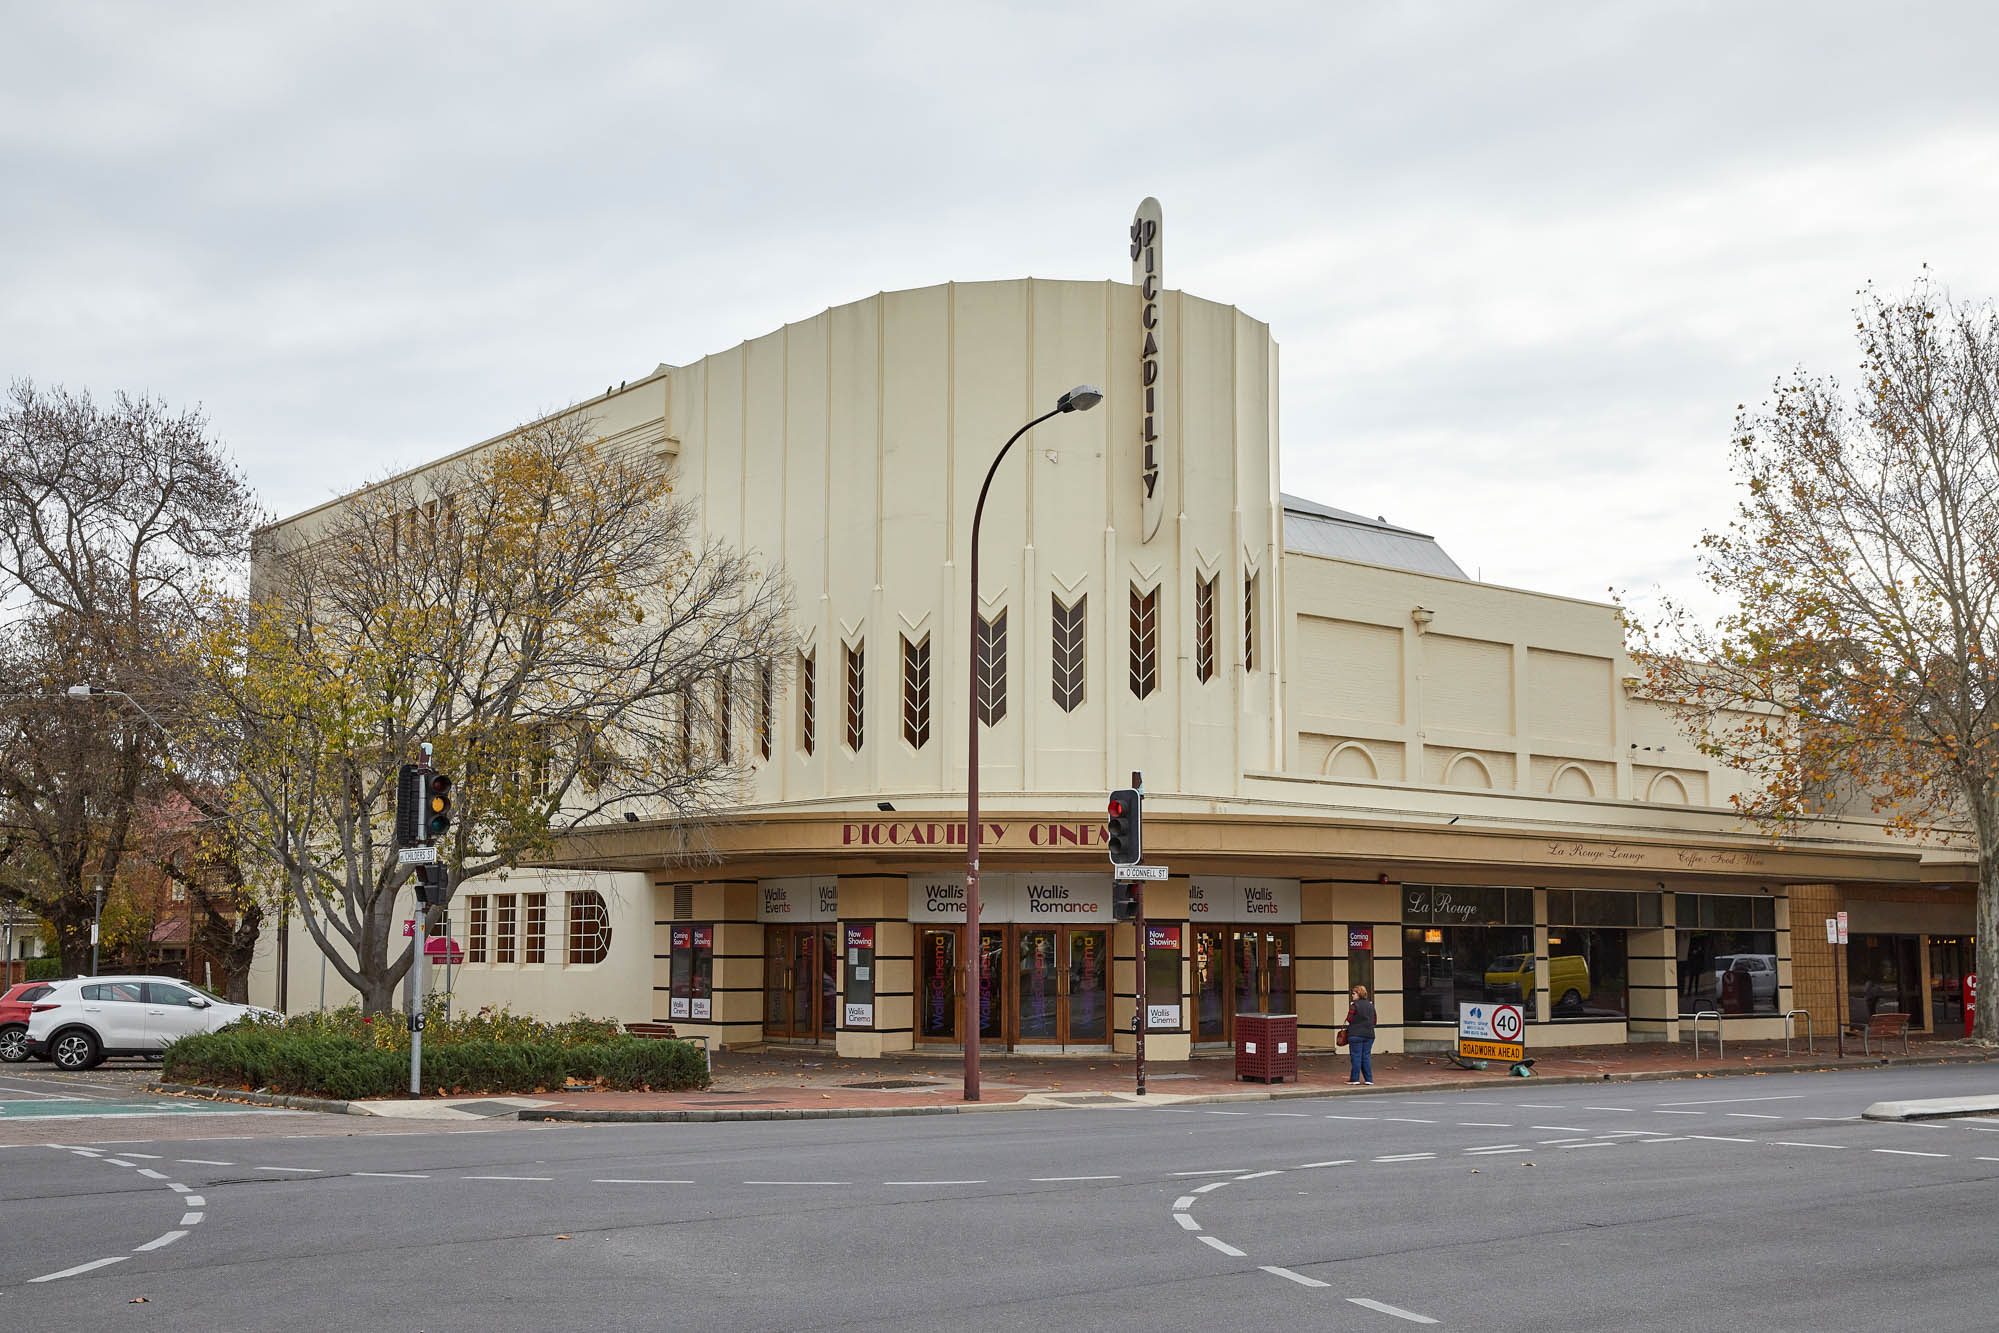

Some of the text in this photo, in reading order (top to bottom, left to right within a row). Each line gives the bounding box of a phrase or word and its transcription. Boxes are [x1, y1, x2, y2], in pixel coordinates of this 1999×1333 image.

[1142, 219, 1158, 499] PICCADILLY
[843, 823, 1110, 846] PICCADILLY CINEM
[1547, 842, 1645, 865] La Rouge Lounge
[1159, 869, 1165, 878] ST
[764, 887, 786, 900] Wallis
[926, 885, 964, 899] Wallis
[1027, 885, 1069, 899] Wallis
[1244, 887, 1273, 900] Wallis
[765, 900, 791, 913] Events
[926, 899, 985, 915] Comey
[1030, 900, 1098, 913] Romance
[1246, 901, 1278, 914] Events
[1407, 891, 1478, 922] La Rouge
[673, 931, 688, 940] Coming
[848, 930, 861, 938] Now
[1149, 930, 1165, 938] Now
[1350, 932, 1369, 941] Coming
[848, 937, 872, 946] Showing
[1149, 937, 1178, 946] Showing
[931, 936, 945, 1030] WallisCinema
[848, 1015, 871, 1023] Cinema
[1150, 1009, 1170, 1017] Wallis
[1151, 1016, 1177, 1024] Cinema
[1496, 1015, 1517, 1032] 40
[1462, 1043, 1520, 1059] ROADWORK AHEAD
